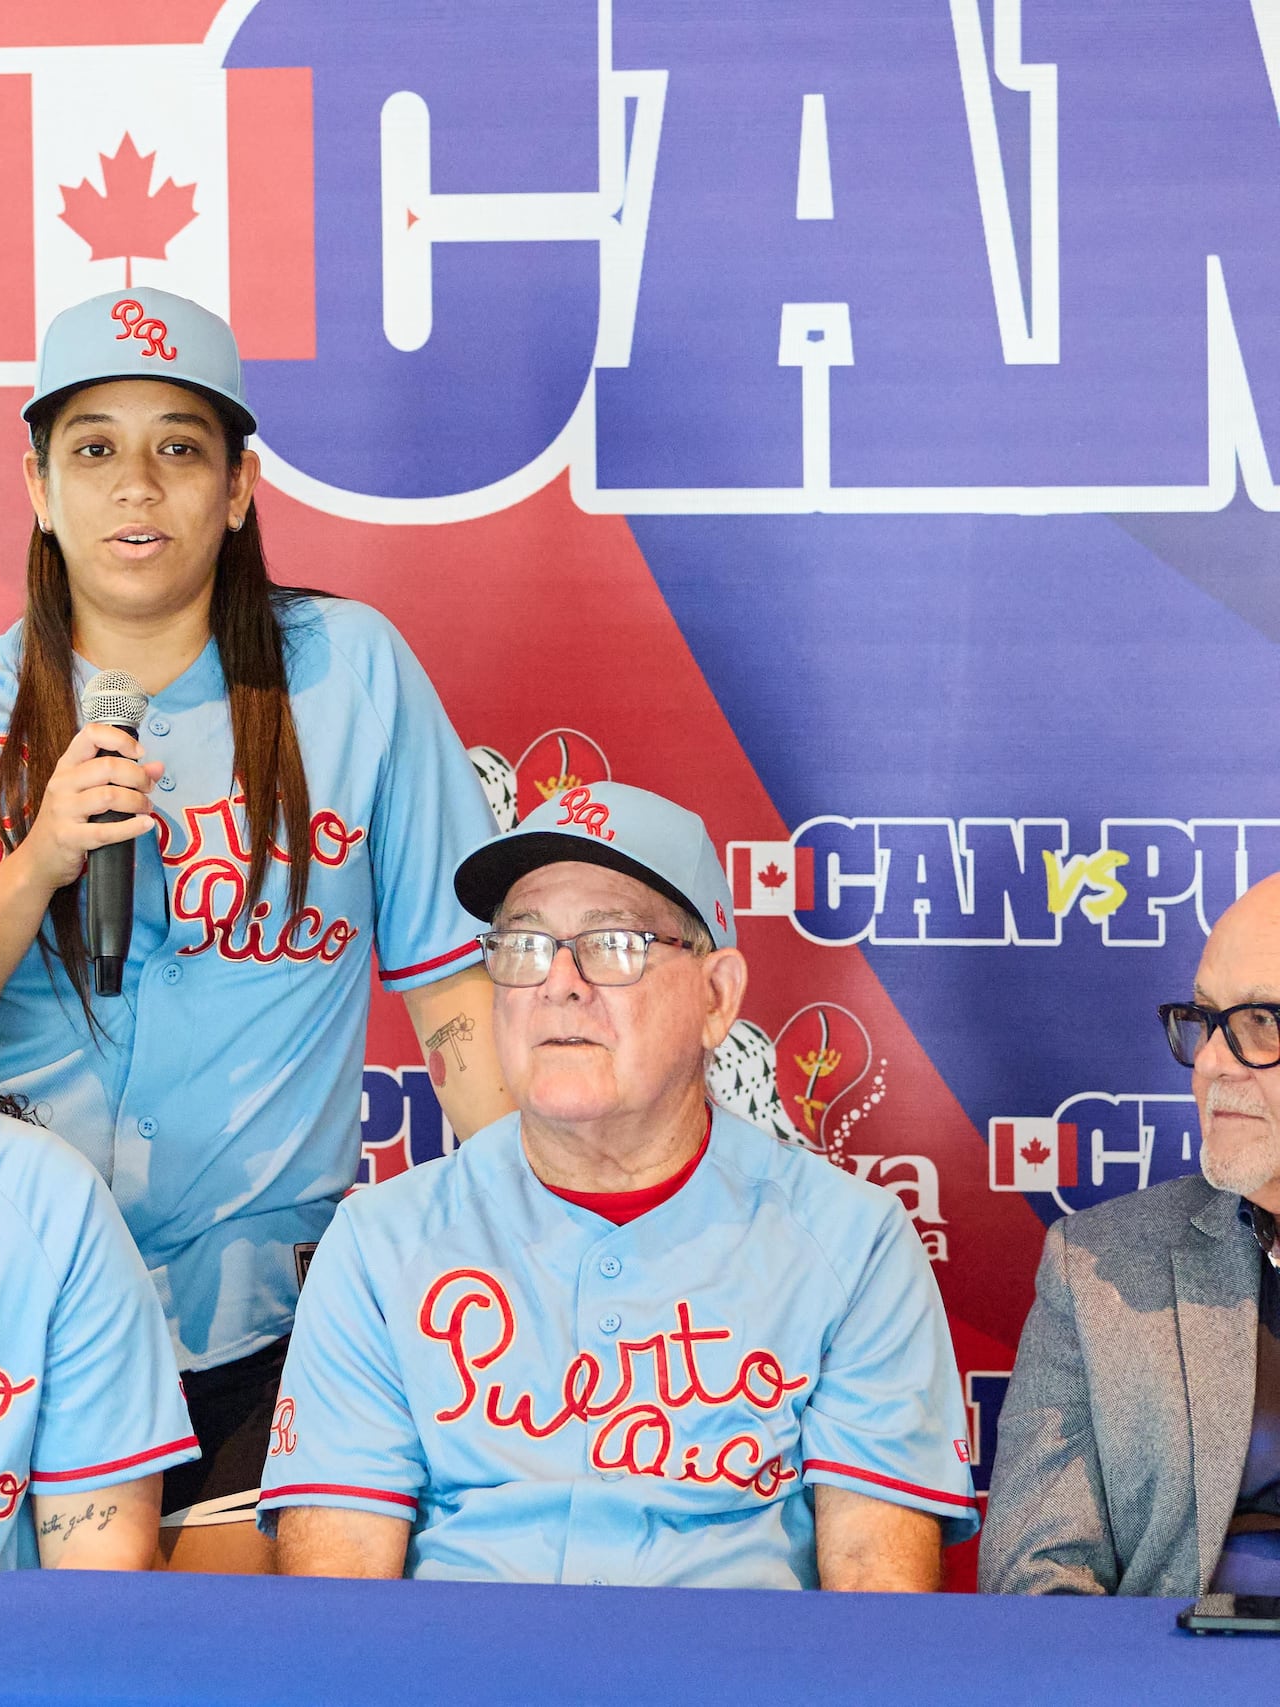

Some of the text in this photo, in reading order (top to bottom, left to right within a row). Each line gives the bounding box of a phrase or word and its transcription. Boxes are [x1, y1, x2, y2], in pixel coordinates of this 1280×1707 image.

[173, 857, 360, 964] Rico
[790, 815, 1069, 946] CAN
[1051, 1091, 1200, 1215] CA
[419, 1268, 808, 1440] Puerto
[269, 1395, 299, 1457] R
[589, 1402, 799, 1499] Rico
